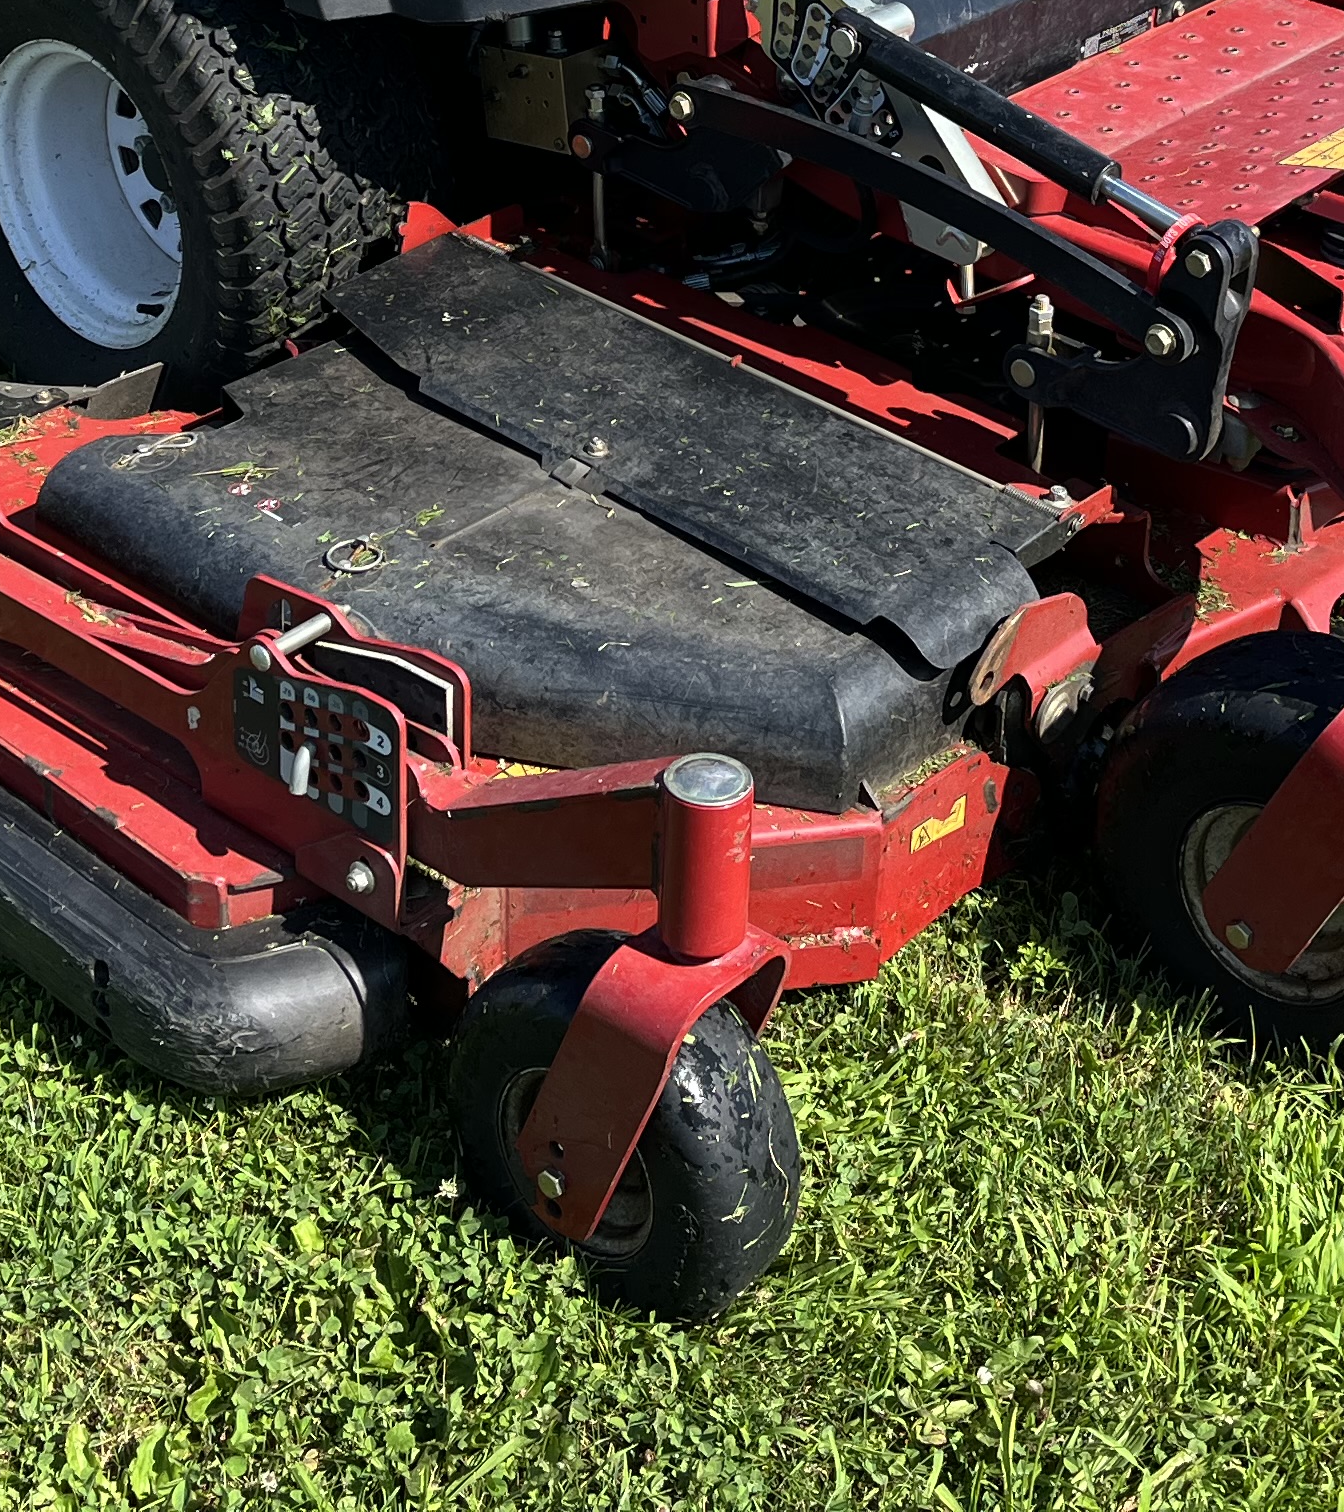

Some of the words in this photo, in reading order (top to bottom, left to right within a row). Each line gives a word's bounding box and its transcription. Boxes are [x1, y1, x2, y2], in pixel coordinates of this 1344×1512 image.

[377, 734, 385, 749] 2
[376, 764, 385, 779] 3
[376, 795, 385, 810] 4
